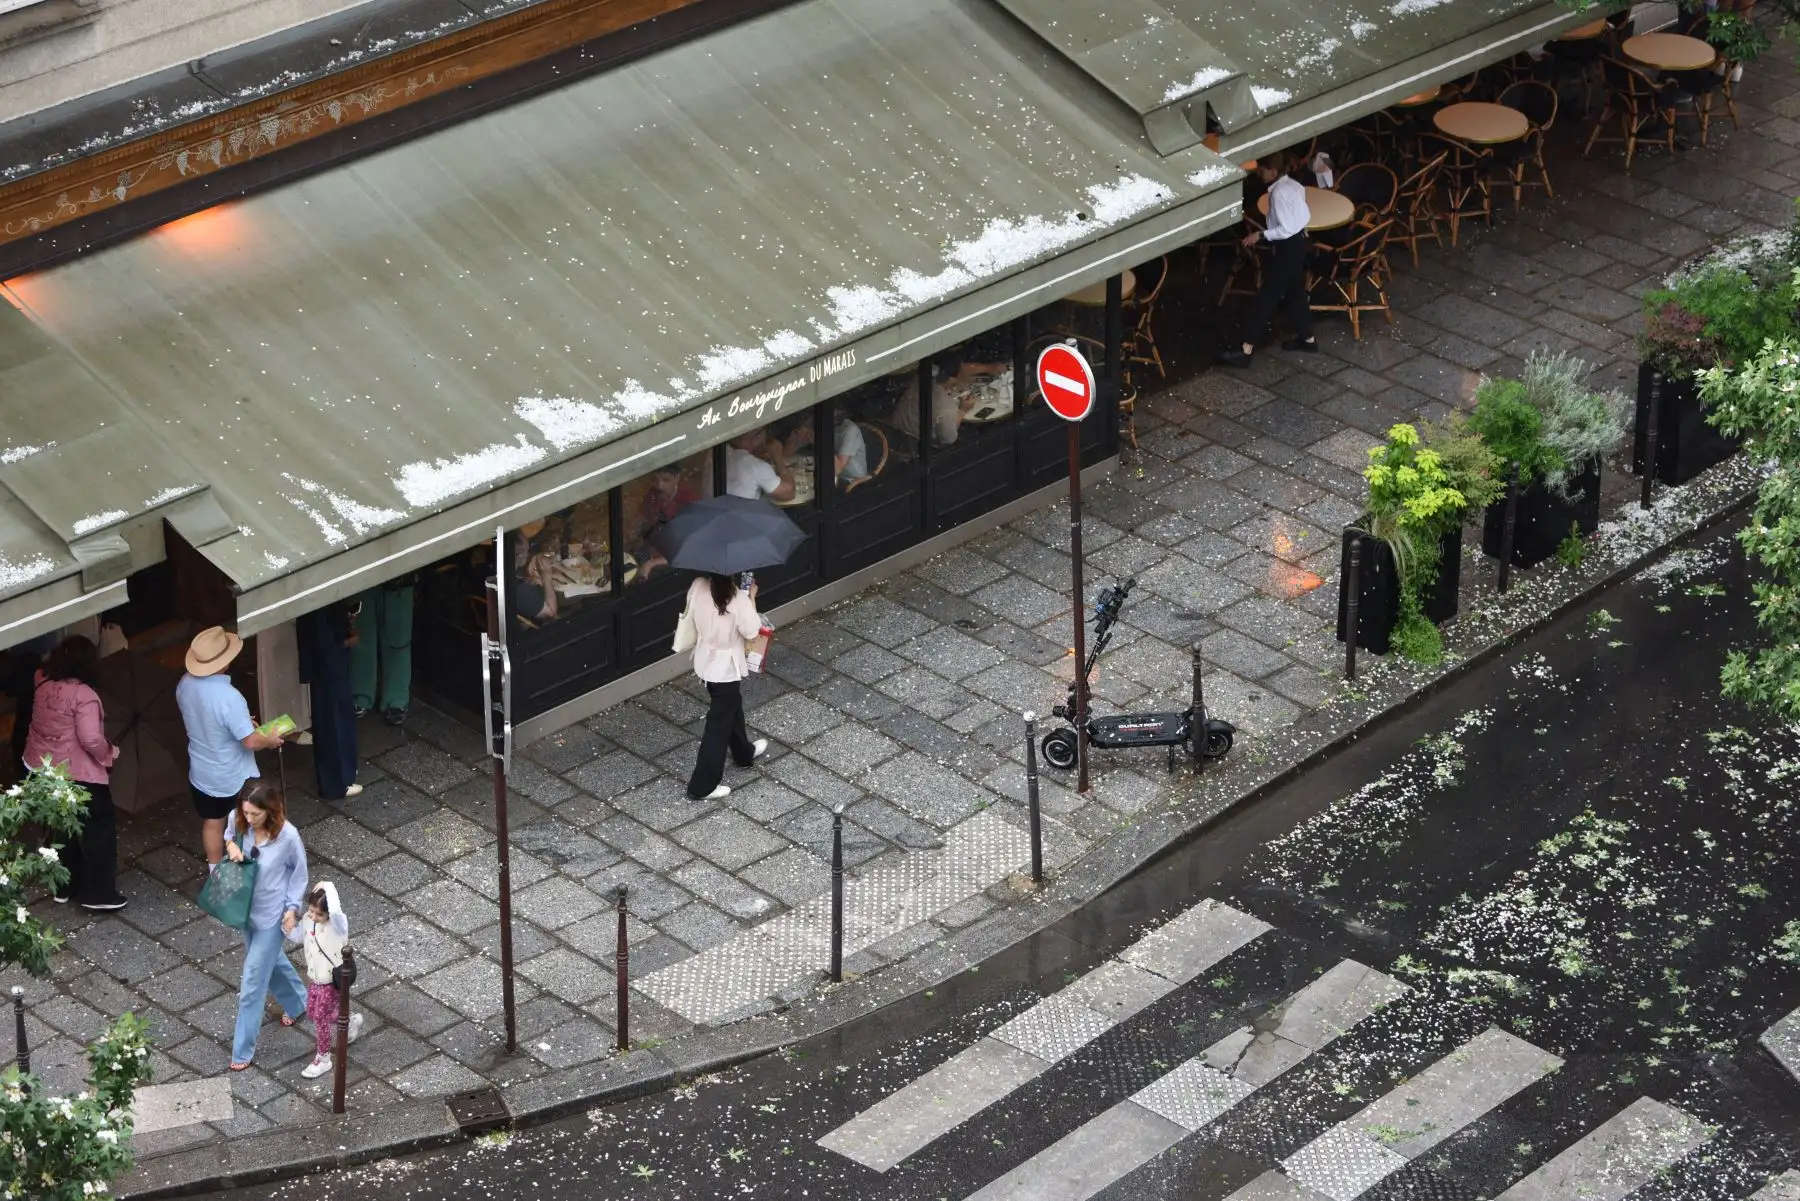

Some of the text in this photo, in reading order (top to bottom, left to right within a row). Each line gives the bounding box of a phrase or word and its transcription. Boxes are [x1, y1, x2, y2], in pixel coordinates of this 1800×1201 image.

[697, 349, 856, 429] Au Bourguignon DU MARAIS
